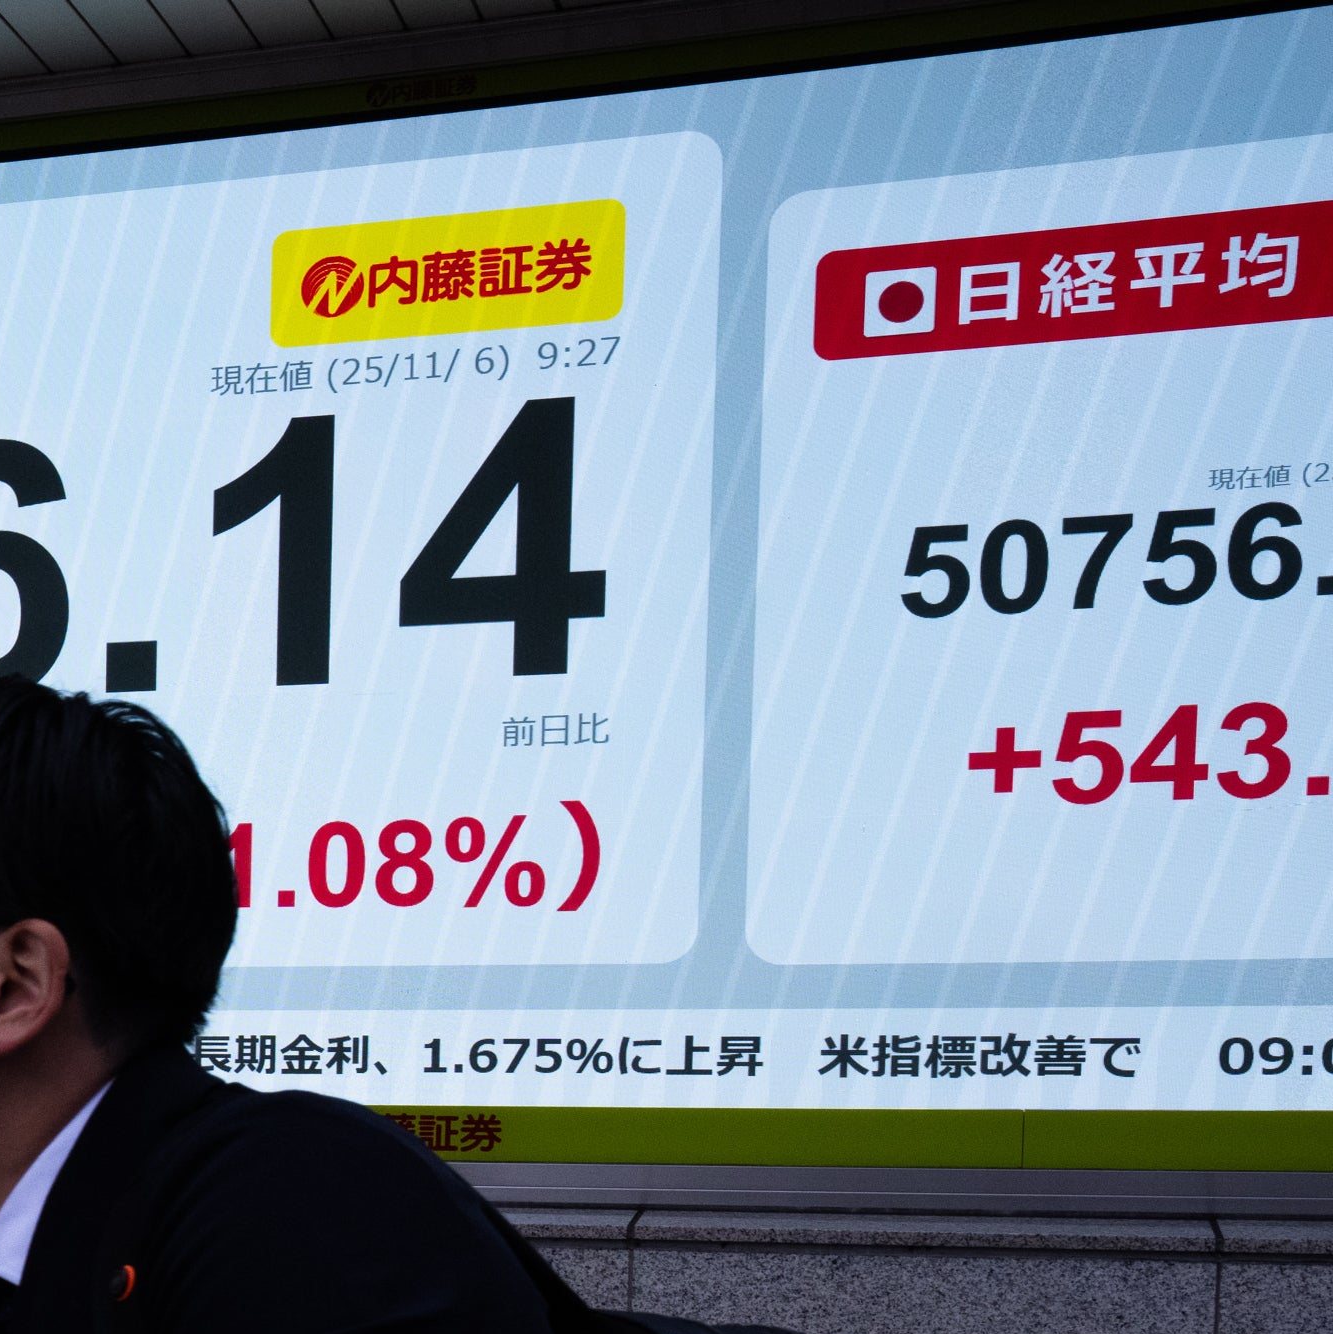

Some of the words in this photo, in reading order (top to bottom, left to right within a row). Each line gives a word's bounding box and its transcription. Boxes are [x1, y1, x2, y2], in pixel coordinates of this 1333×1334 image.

[367, 237, 592, 308] 内藤証券
[958, 233, 1300, 325] 日経平均
[211, 361, 313, 396] 現在値
[537, 335, 621, 371] 9:27
[1208, 464, 1291, 491] 現在値
[1302, 462, 1333, 488] (2
[502, 713, 610, 747] 前日比
[969, 702, 1329, 805] +543.
[818, 1034, 1142, 1079] 米指標改善で
